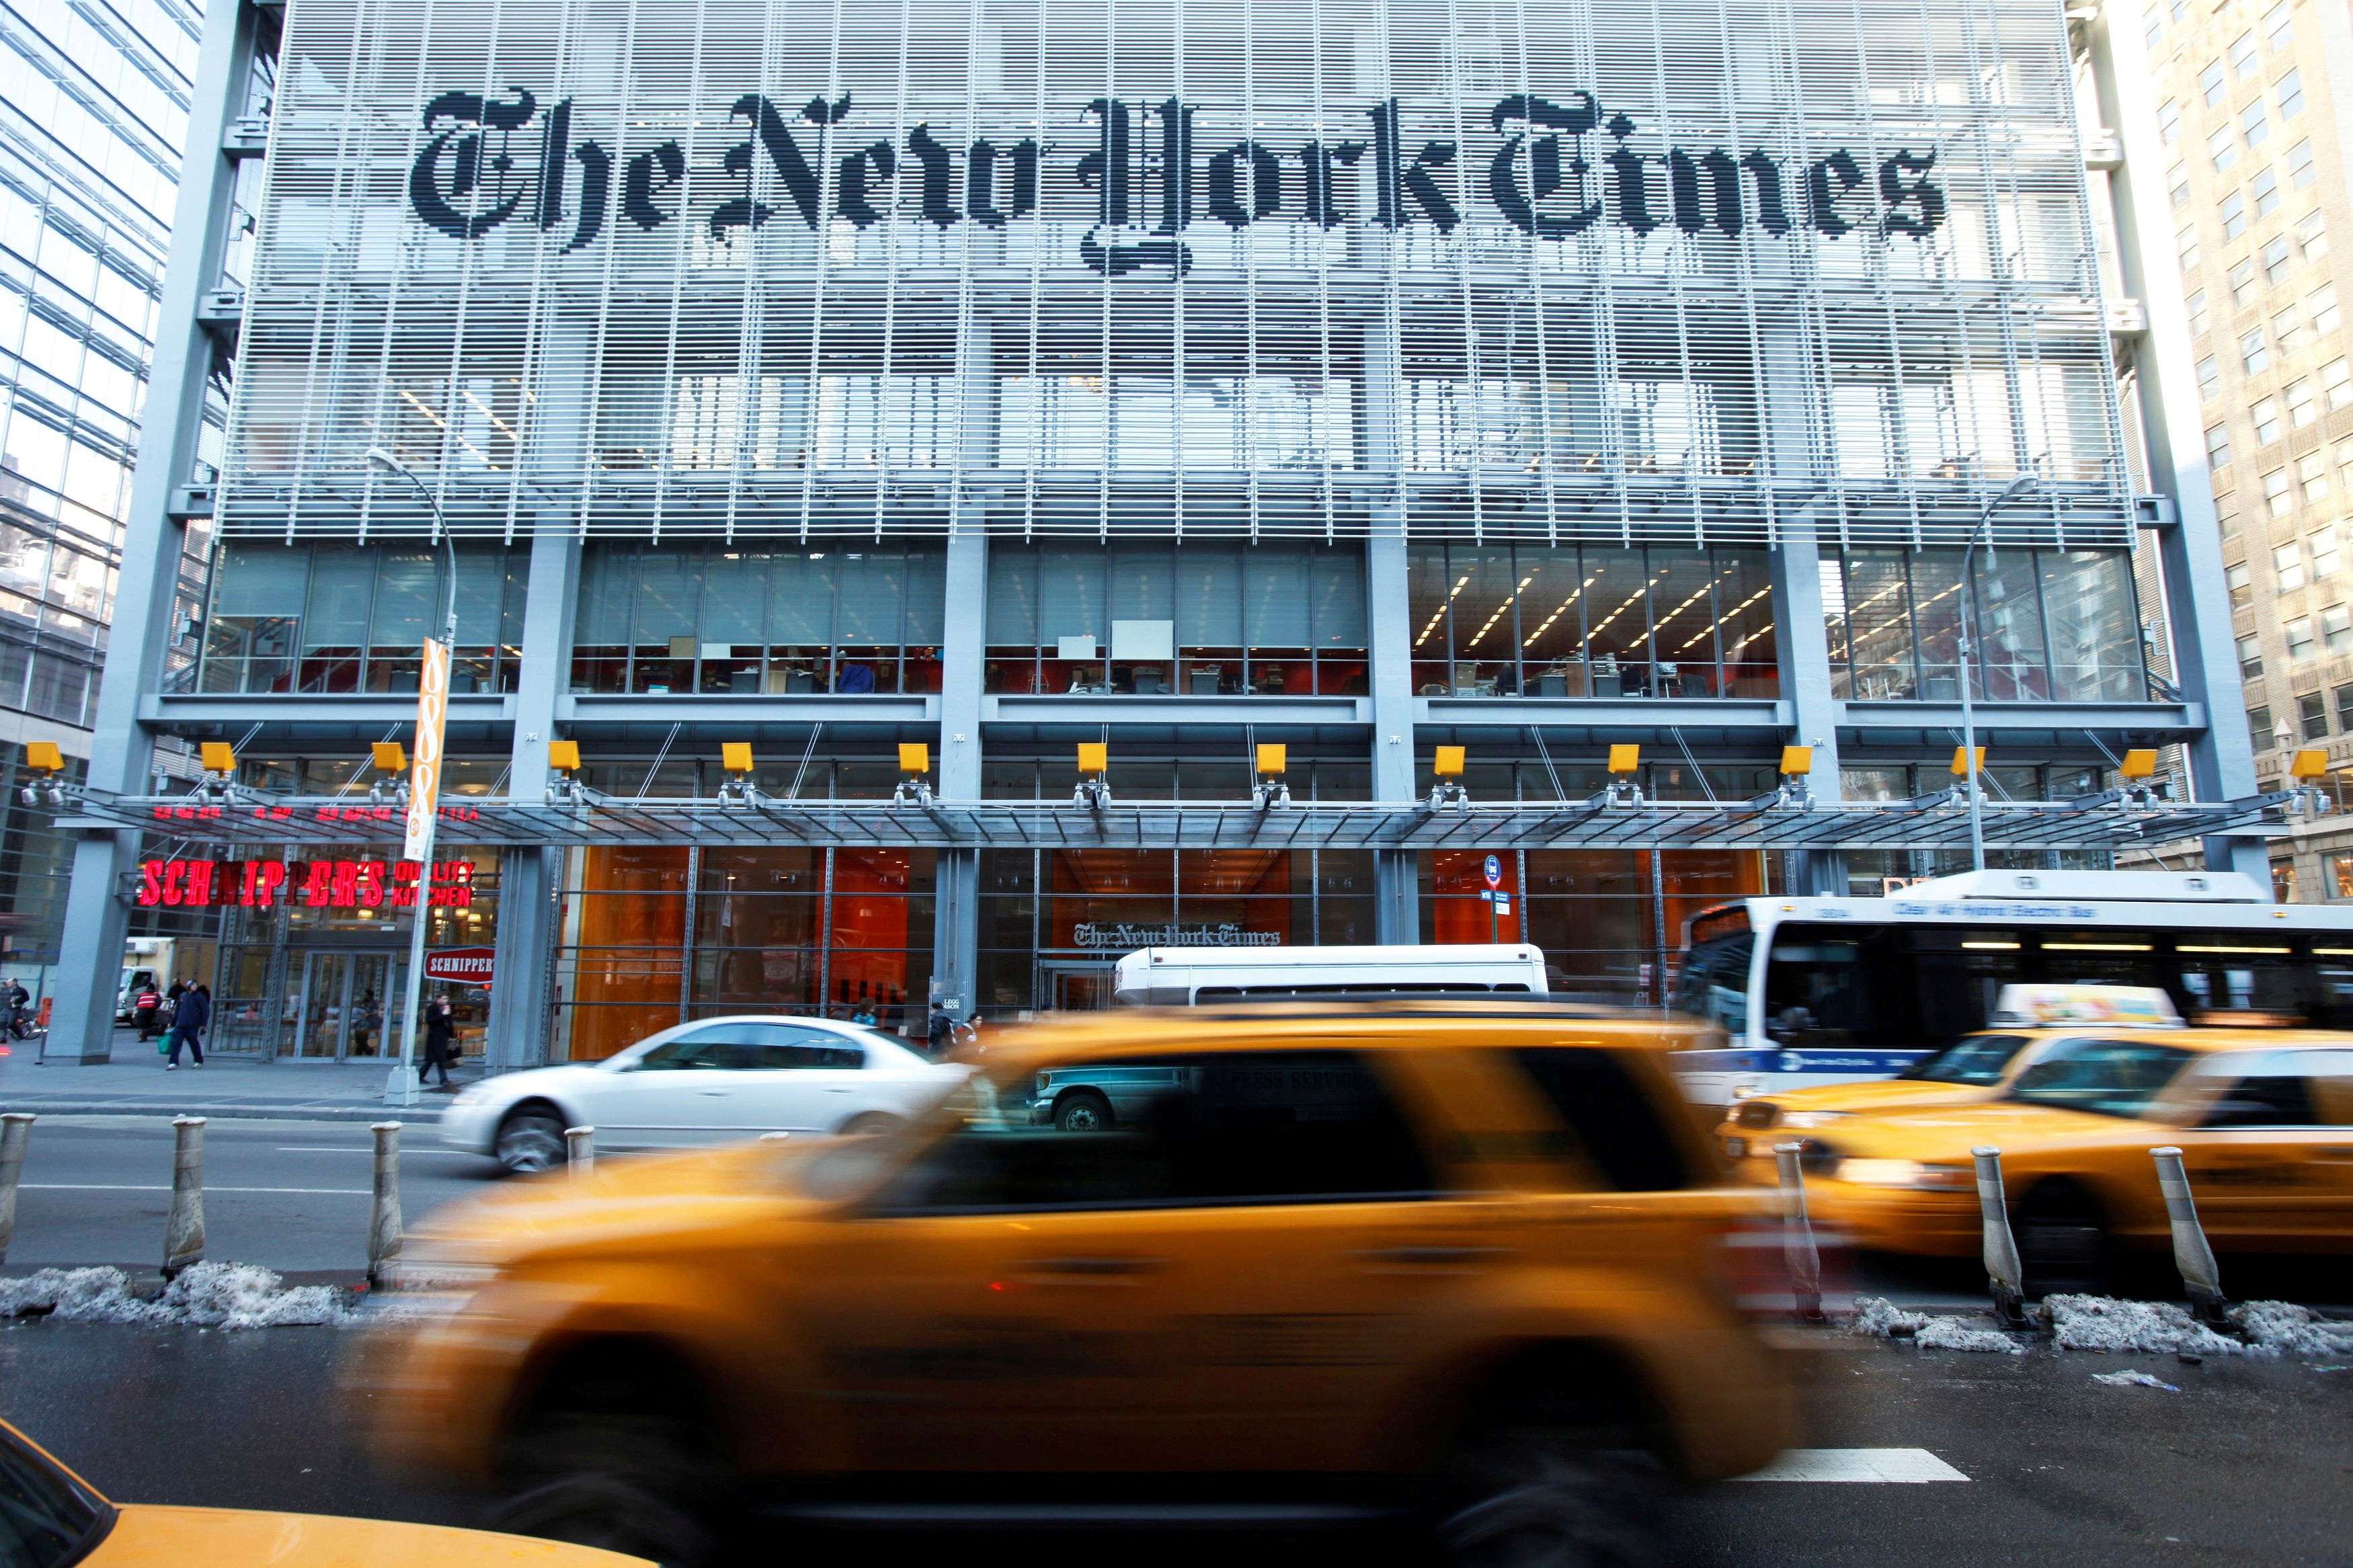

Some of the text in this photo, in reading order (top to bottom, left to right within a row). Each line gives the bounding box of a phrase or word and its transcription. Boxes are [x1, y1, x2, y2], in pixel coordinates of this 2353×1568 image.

[408, 86, 1948, 282] The New York Times
[138, 860, 387, 907] SCHNIPPER'S
[394, 861, 475, 882] QULITY
[1074, 923, 1281, 949] The New York Times
[430, 957, 495, 972] SCHNIPPER'
